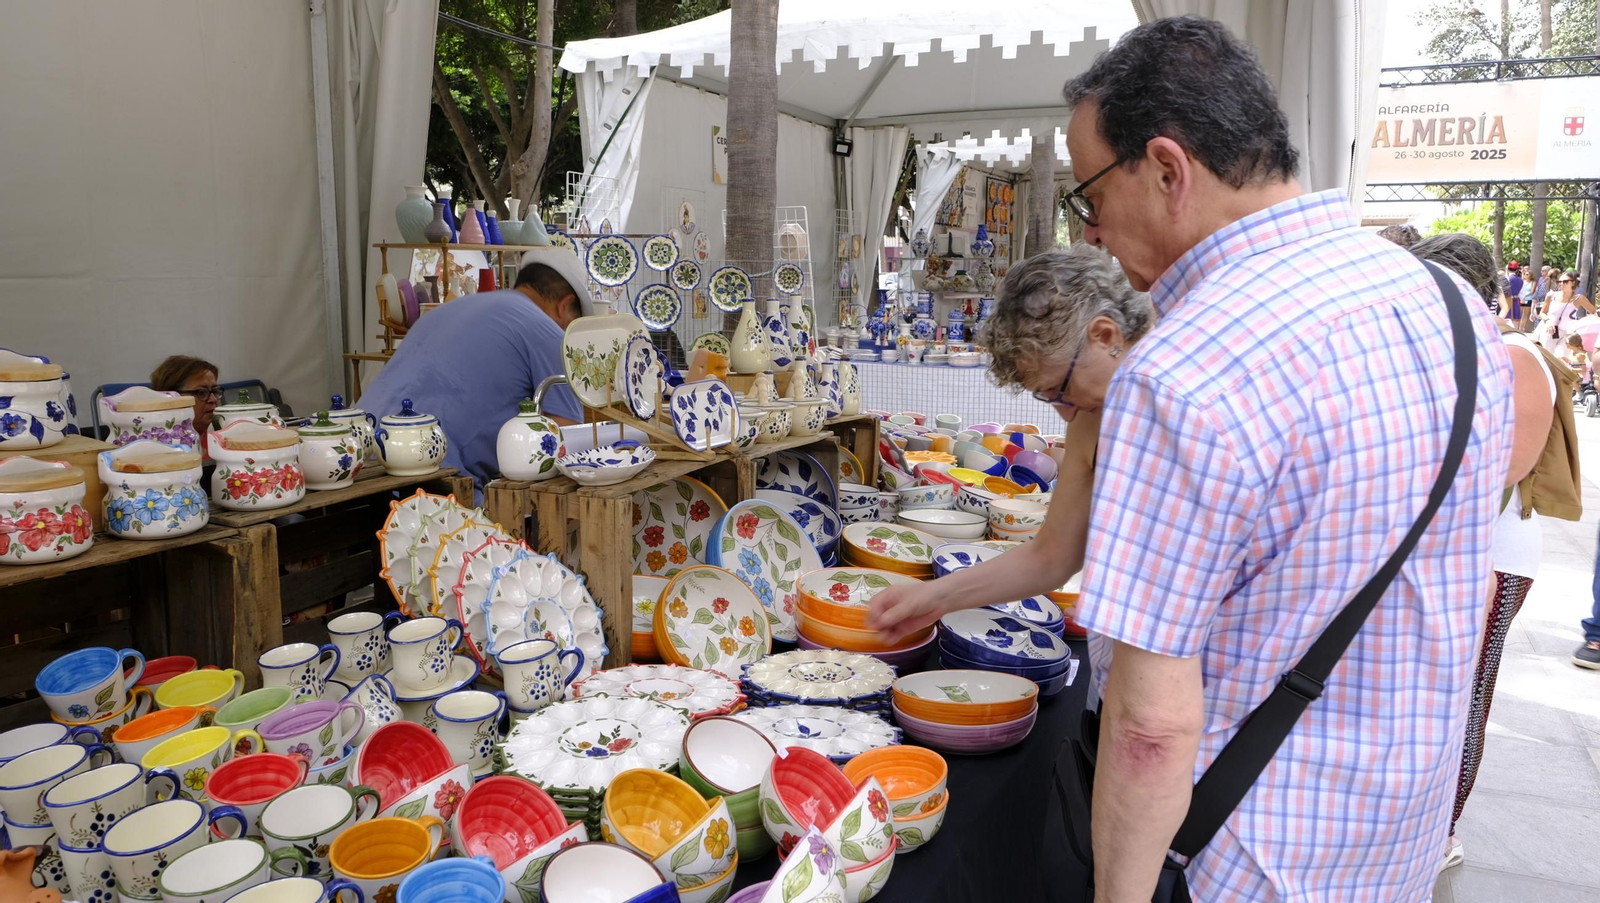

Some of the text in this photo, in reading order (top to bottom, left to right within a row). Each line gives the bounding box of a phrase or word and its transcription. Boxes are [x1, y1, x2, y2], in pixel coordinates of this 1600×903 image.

[1378, 102, 1450, 115] ALFARERÍA
[1371, 112, 1508, 148] ALMERÍA
[1428, 150, 1465, 160] agosto
[1470, 149, 1507, 160] 2025
